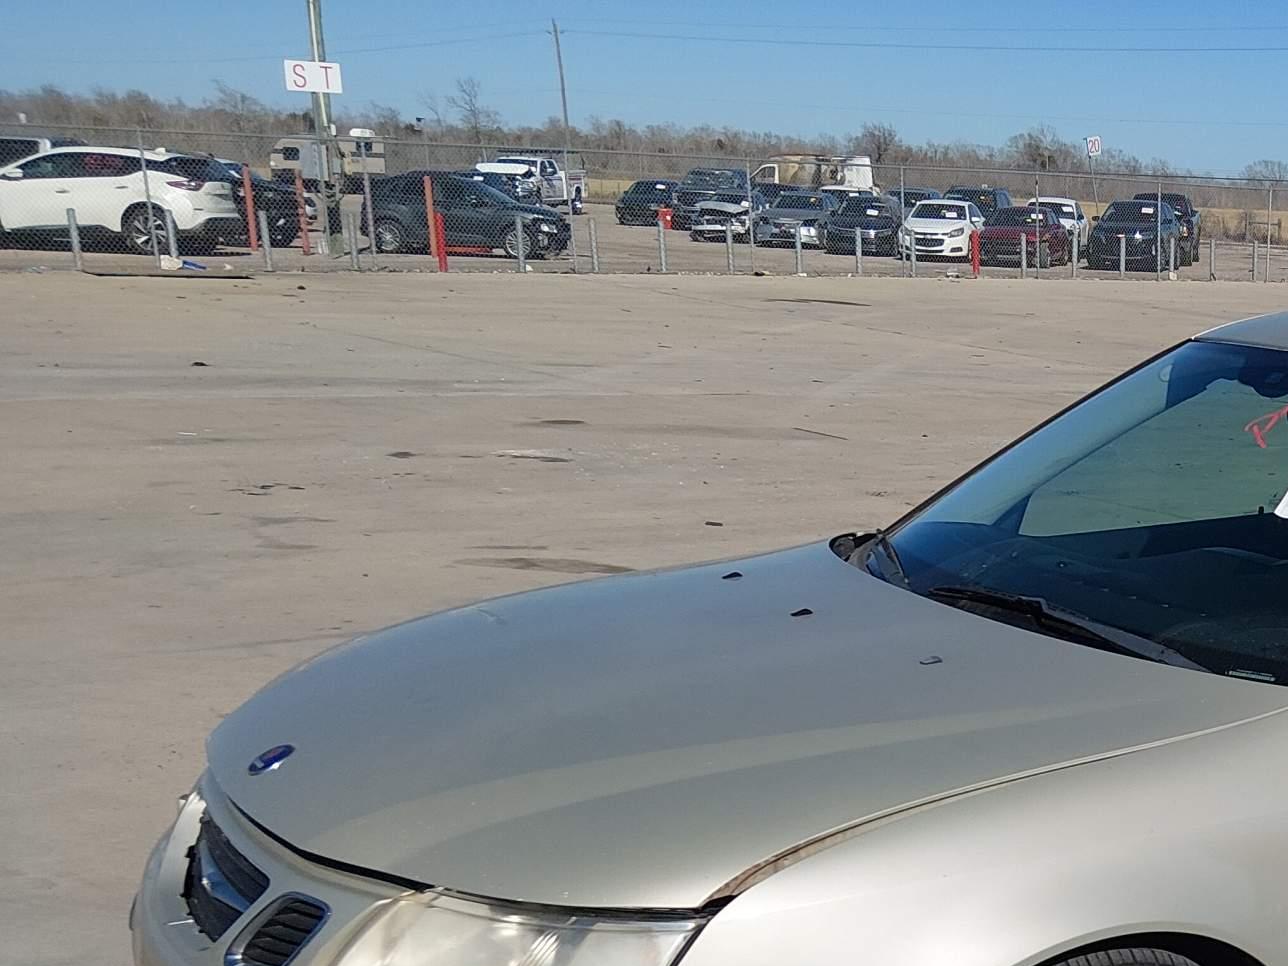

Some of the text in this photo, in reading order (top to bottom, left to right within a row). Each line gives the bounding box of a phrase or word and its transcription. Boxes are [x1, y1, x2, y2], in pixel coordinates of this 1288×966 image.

[293, 64, 332, 89] S T
[1089, 139, 1100, 153] 20
